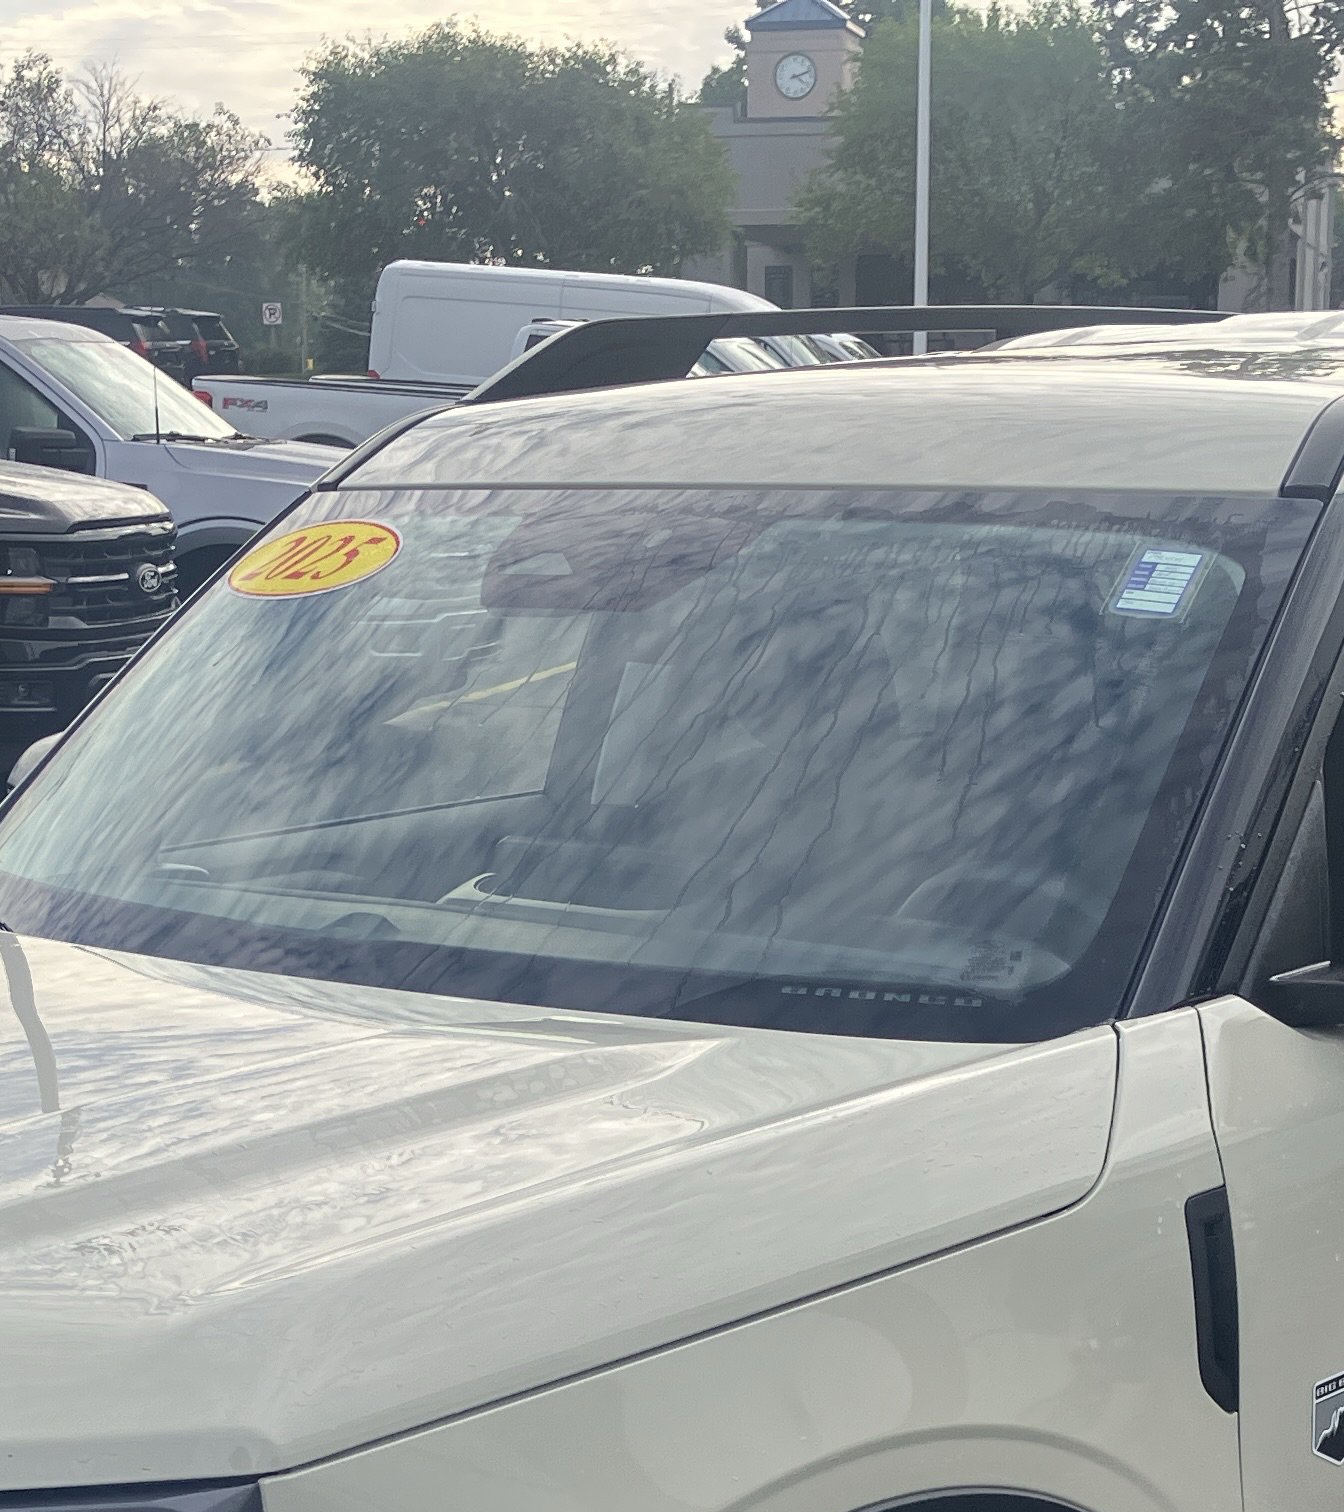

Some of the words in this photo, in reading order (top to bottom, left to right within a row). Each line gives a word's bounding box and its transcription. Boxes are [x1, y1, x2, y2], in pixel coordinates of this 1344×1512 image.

[222, 397, 268, 410] FX4
[239, 535, 388, 581] 2025
[781, 985, 983, 1008] BRONCO
[1316, 1381, 1337, 1397] BIG
